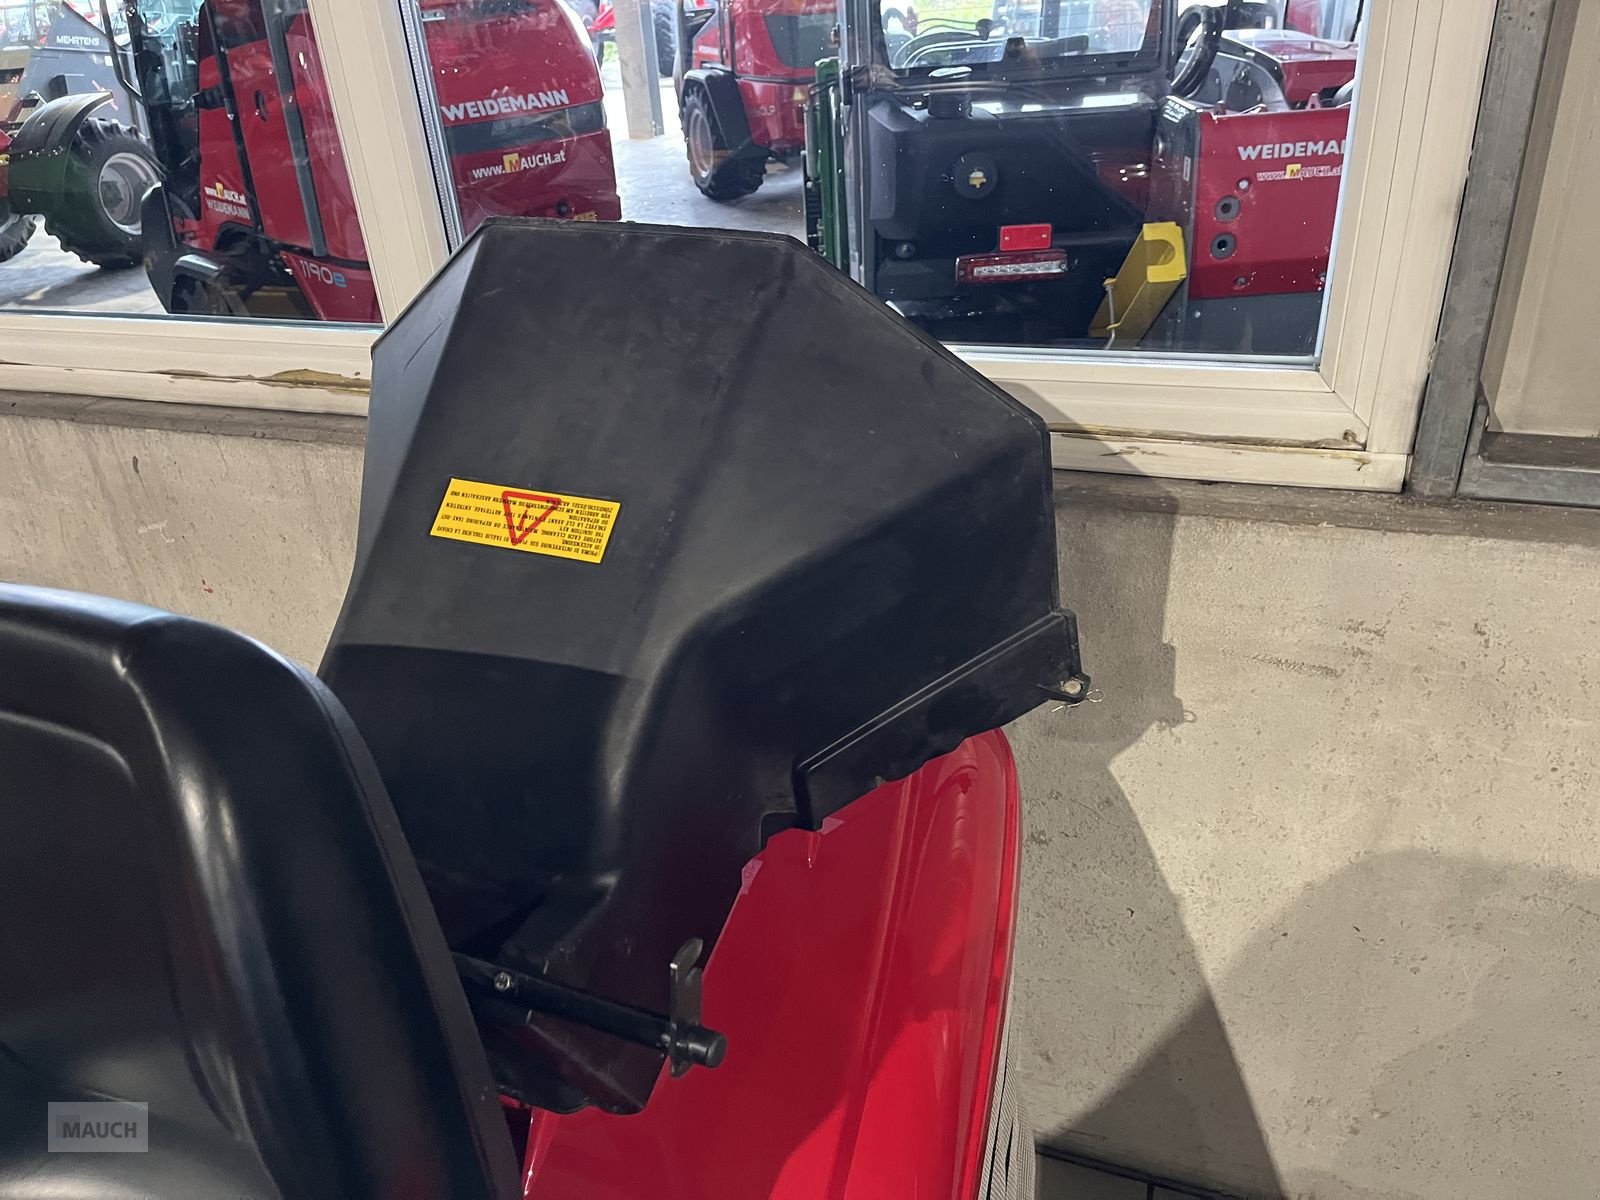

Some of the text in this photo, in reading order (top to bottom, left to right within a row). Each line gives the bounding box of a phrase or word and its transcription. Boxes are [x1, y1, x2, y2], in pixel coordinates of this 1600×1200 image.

[440, 88, 570, 122] WEIDEMANN
[472, 150, 567, 180] www.MAUCH.at
[299, 259, 347, 288] 1190e
